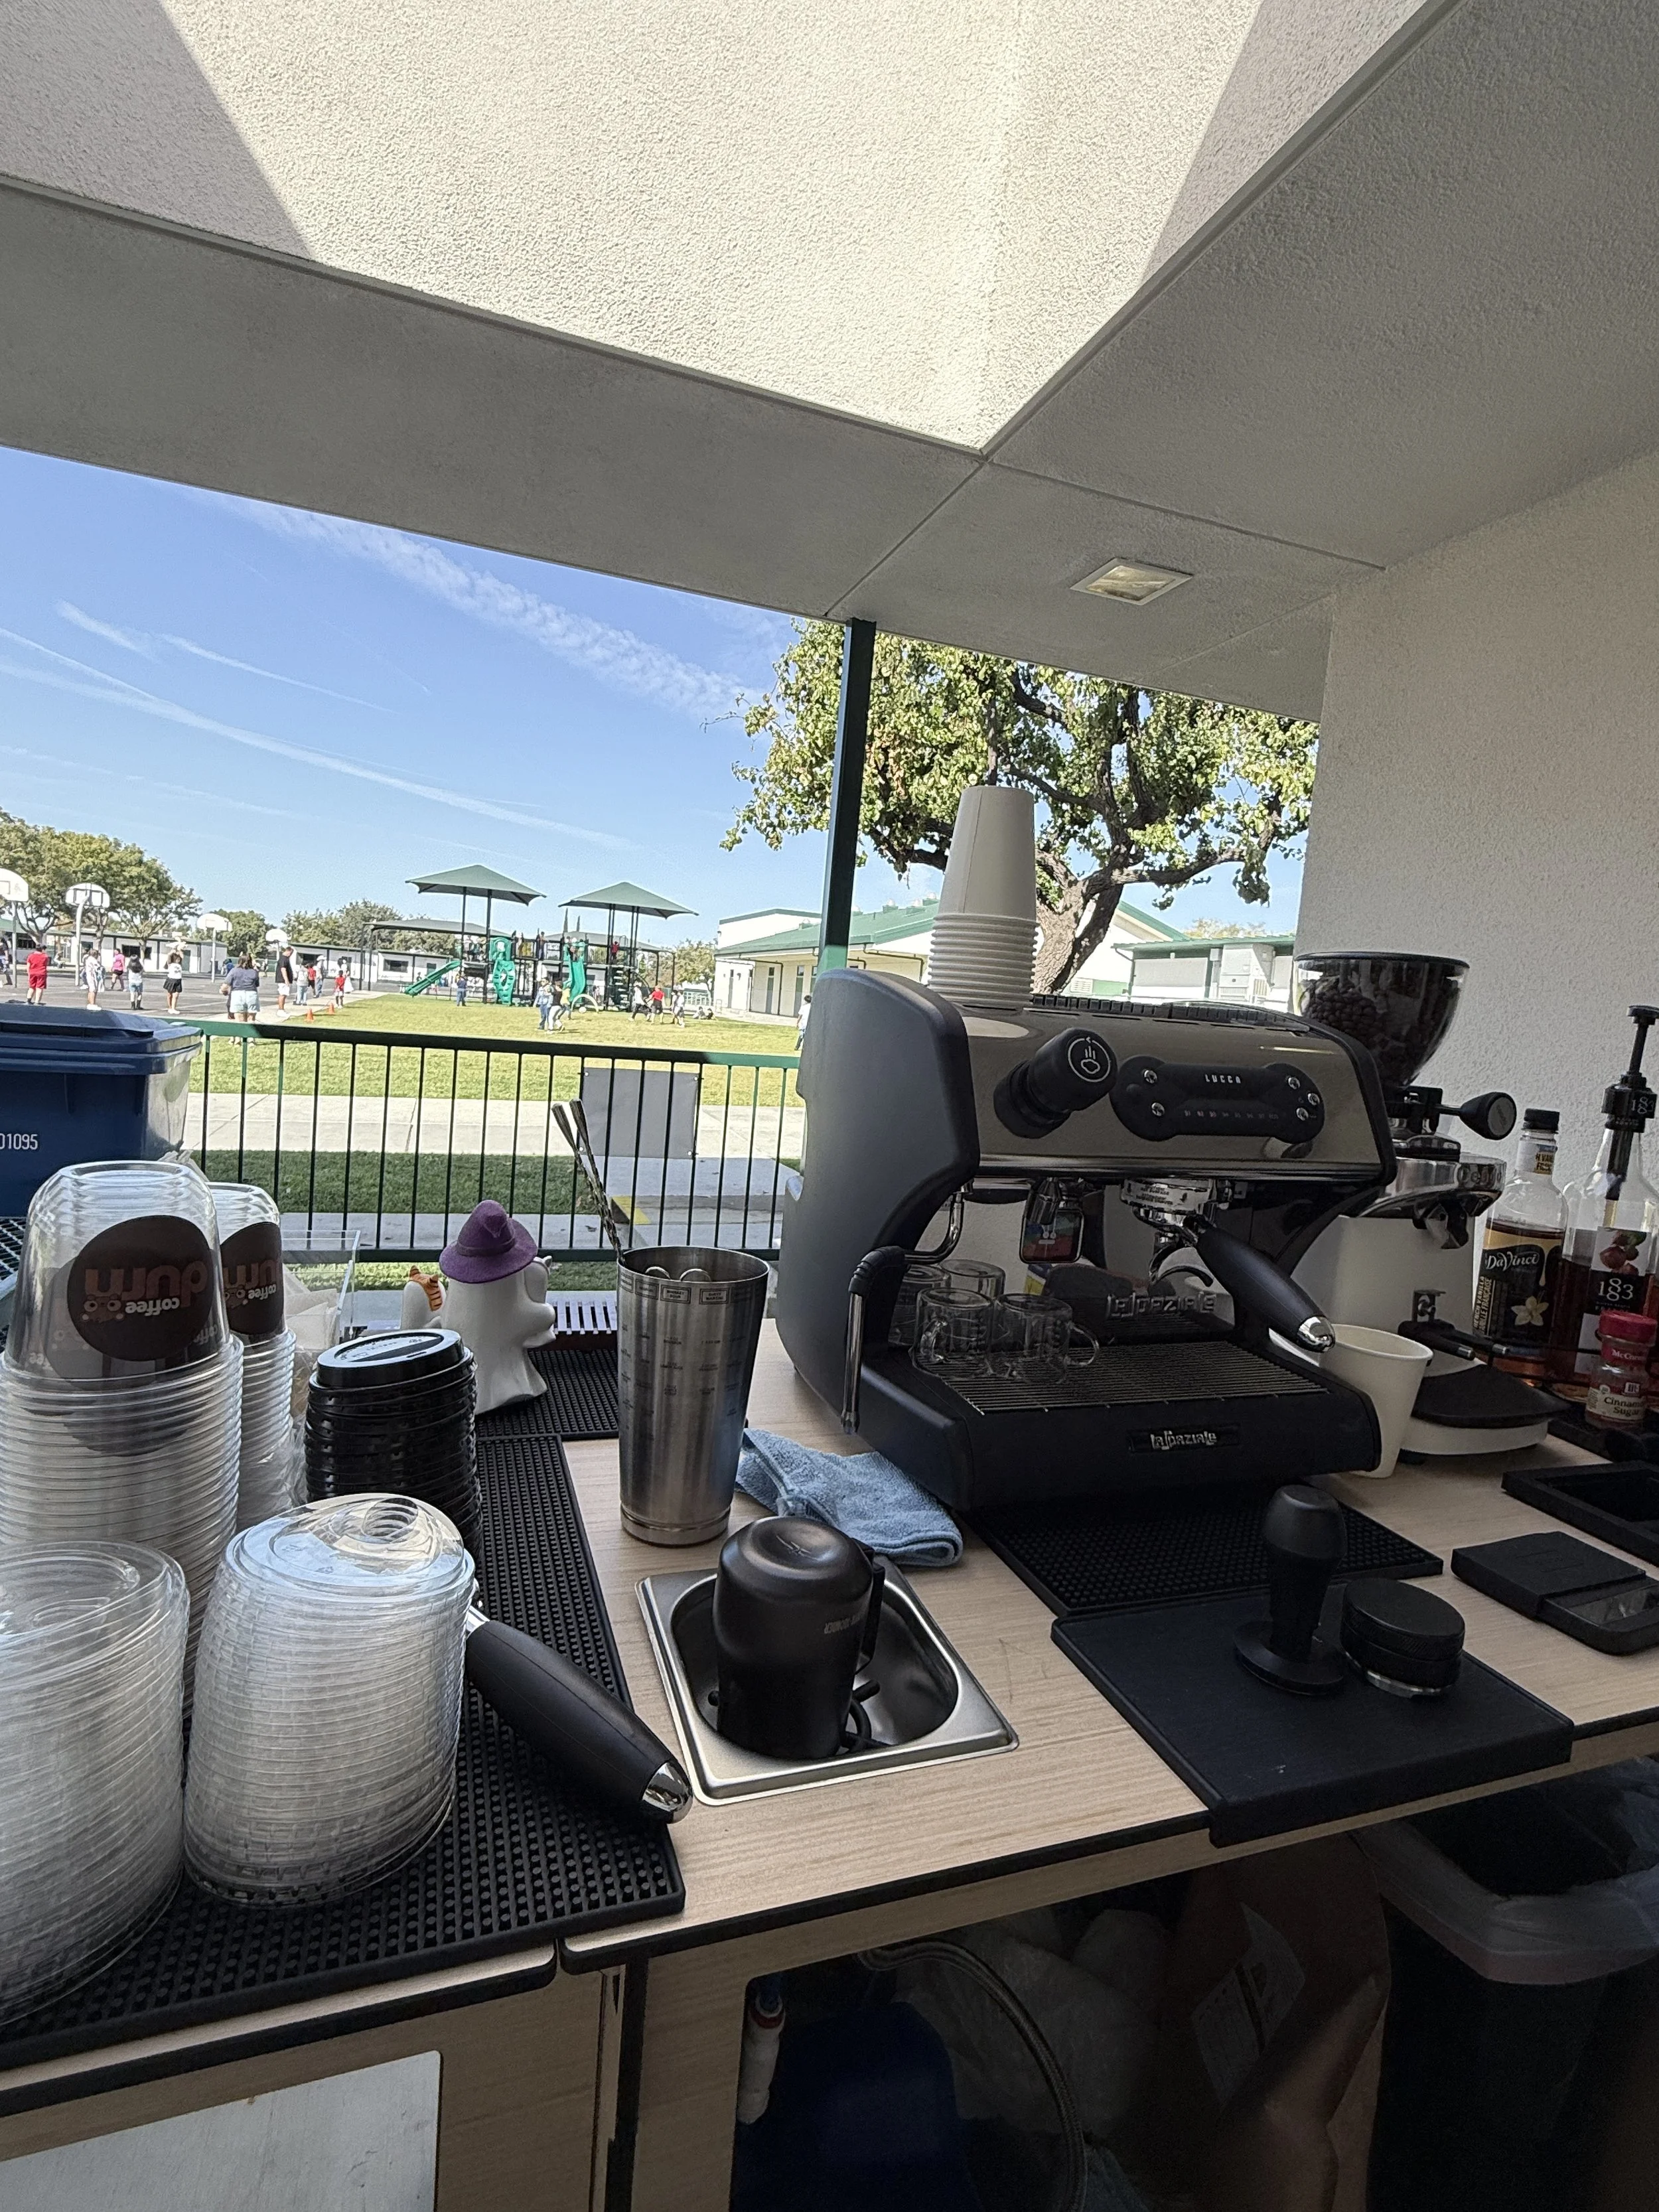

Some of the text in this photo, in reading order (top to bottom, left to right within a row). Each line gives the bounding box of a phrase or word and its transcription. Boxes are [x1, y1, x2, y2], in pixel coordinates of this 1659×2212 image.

[1204, 1074, 1242, 1084] LUCCA
[248, 1283, 277, 1301] coffee
[1598, 1278, 1634, 1302] 183
[125, 1297, 180, 1317] coffee
[1613, 1406, 1640, 1418] Sugar
